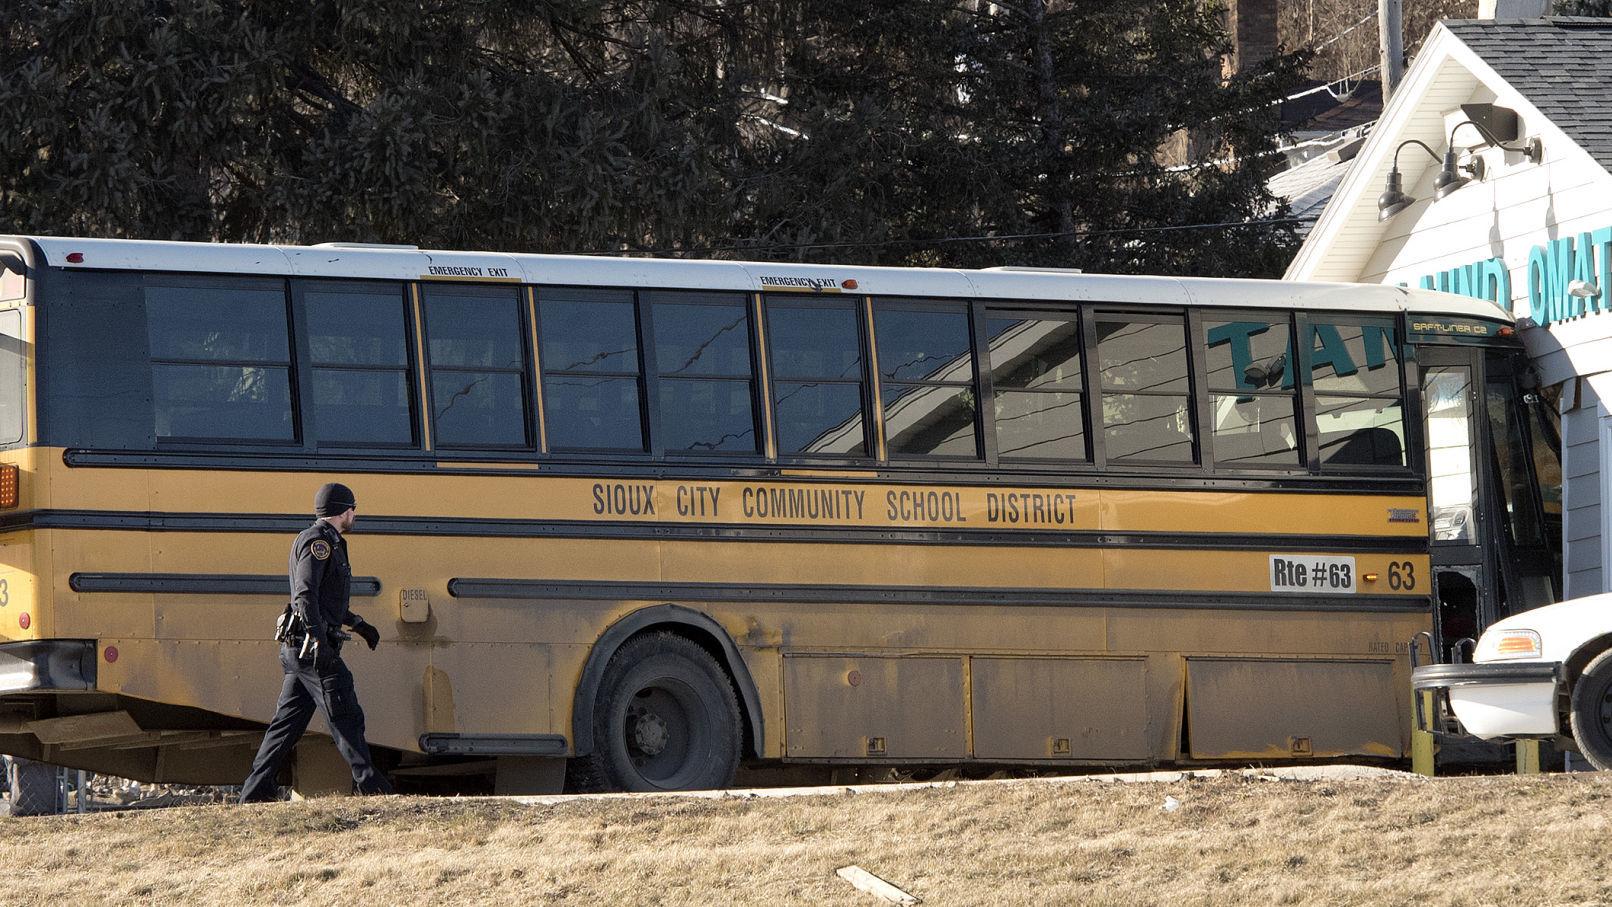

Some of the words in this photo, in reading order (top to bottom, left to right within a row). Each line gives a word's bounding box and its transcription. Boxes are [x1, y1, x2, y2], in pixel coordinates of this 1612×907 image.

[428, 266, 482, 276] EMERGENCY
[488, 268, 508, 277] EXIT
[760, 276, 811, 287] EMERGENCY
[817, 279, 836, 287] EXIT
[592, 483, 656, 515] SIOUX
[676, 485, 721, 516] CITY
[742, 487, 865, 519] COMMUNITY
[887, 490, 967, 522] SCHOOL
[987, 492, 1076, 524] DISTRICT
[1273, 558, 1307, 587] Rte
[1312, 562, 1352, 588] #63
[1387, 561, 1416, 591] 63
[402, 589, 427, 600] DIESEL
